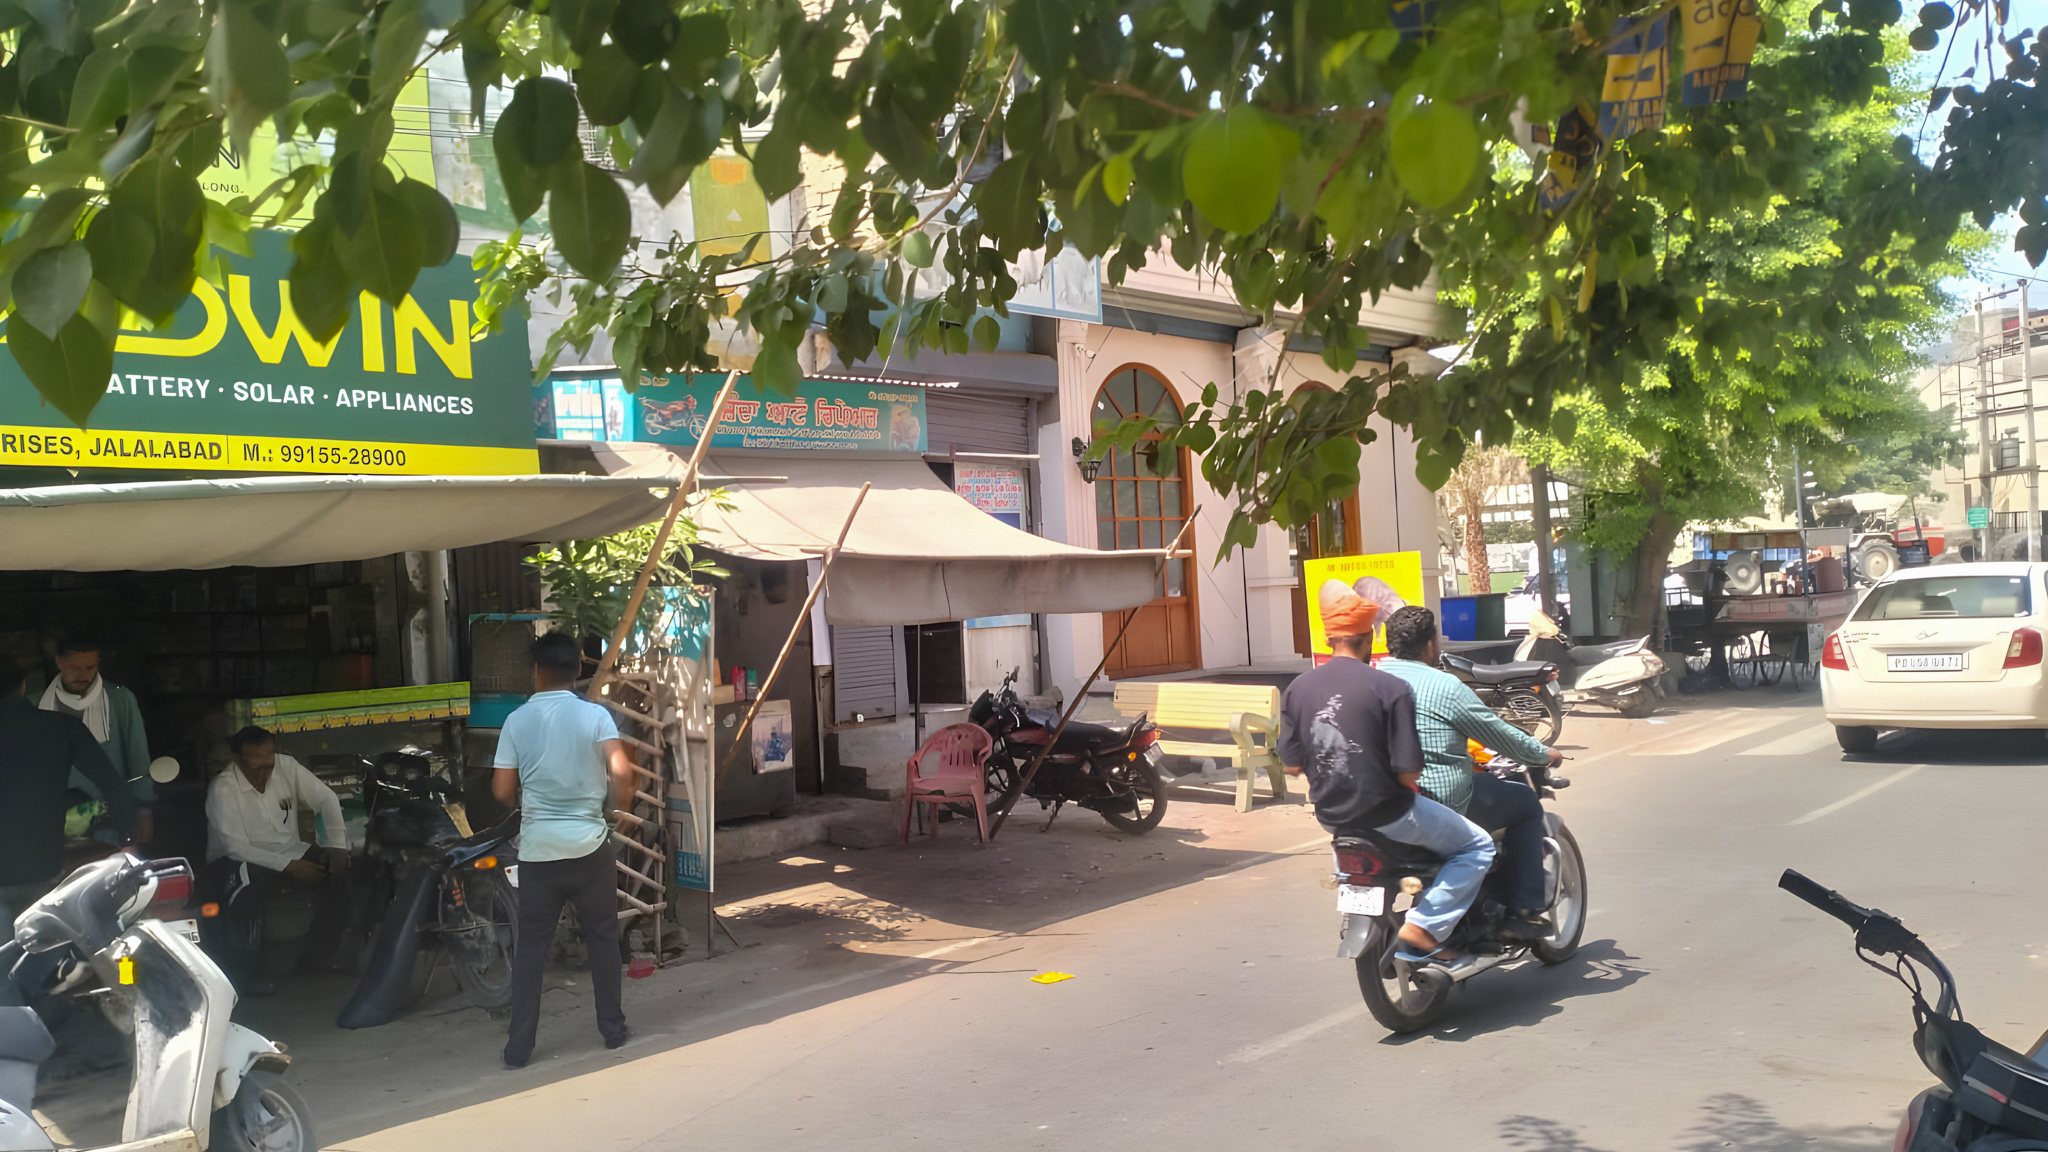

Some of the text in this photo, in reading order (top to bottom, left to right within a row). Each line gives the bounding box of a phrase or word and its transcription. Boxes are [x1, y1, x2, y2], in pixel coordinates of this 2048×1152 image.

[105, 373, 474, 415] ATTERY SOLAR APPLIANCES
[1, 433, 80, 460] RISES,
[89, 437, 222, 461] JALALABAD
[280, 444, 406, 467] 99155-28900
